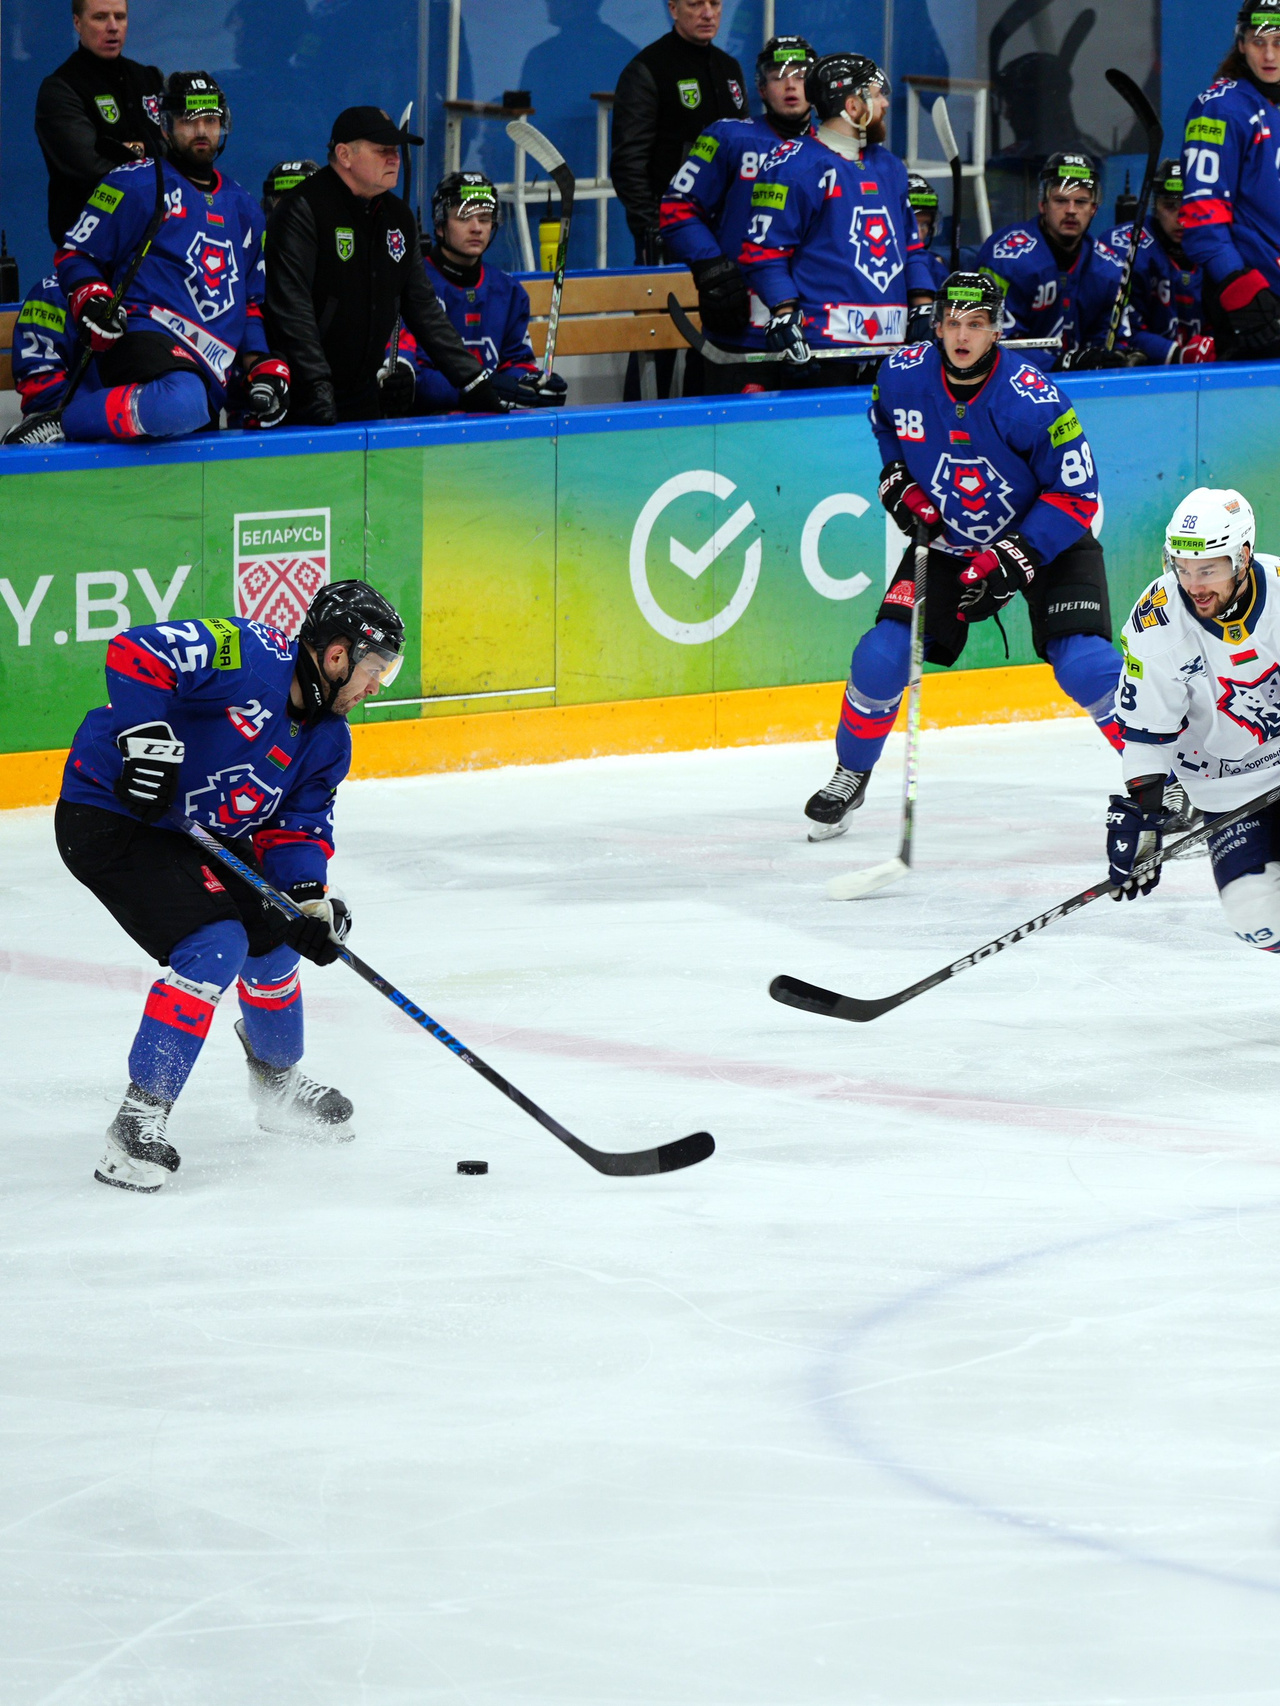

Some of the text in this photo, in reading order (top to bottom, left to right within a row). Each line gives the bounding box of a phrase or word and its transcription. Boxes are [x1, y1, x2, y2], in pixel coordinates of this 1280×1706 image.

[191, 79, 207, 89] 18
[282, 162, 302, 171] 68
[1063, 156, 1083, 166] 90
[669, 161, 701, 194] 6
[948, 290, 982, 299] BETERA
[1182, 515, 1198, 529] 98
[242, 526, 323, 547] БЕЛАРУСЬ
[1172, 539, 1204, 548] BETERA
[0, 565, 192, 647] Y.BY
[156, 620, 209, 673] 25
[229, 699, 273, 738] 25
[1237, 819, 1261, 835] Дом
[293, 881, 318, 890] CCM
[950, 905, 1065, 977] SOYUZ
[176, 979, 203, 995] CCM
[389, 989, 468, 1055] SOYUZ
